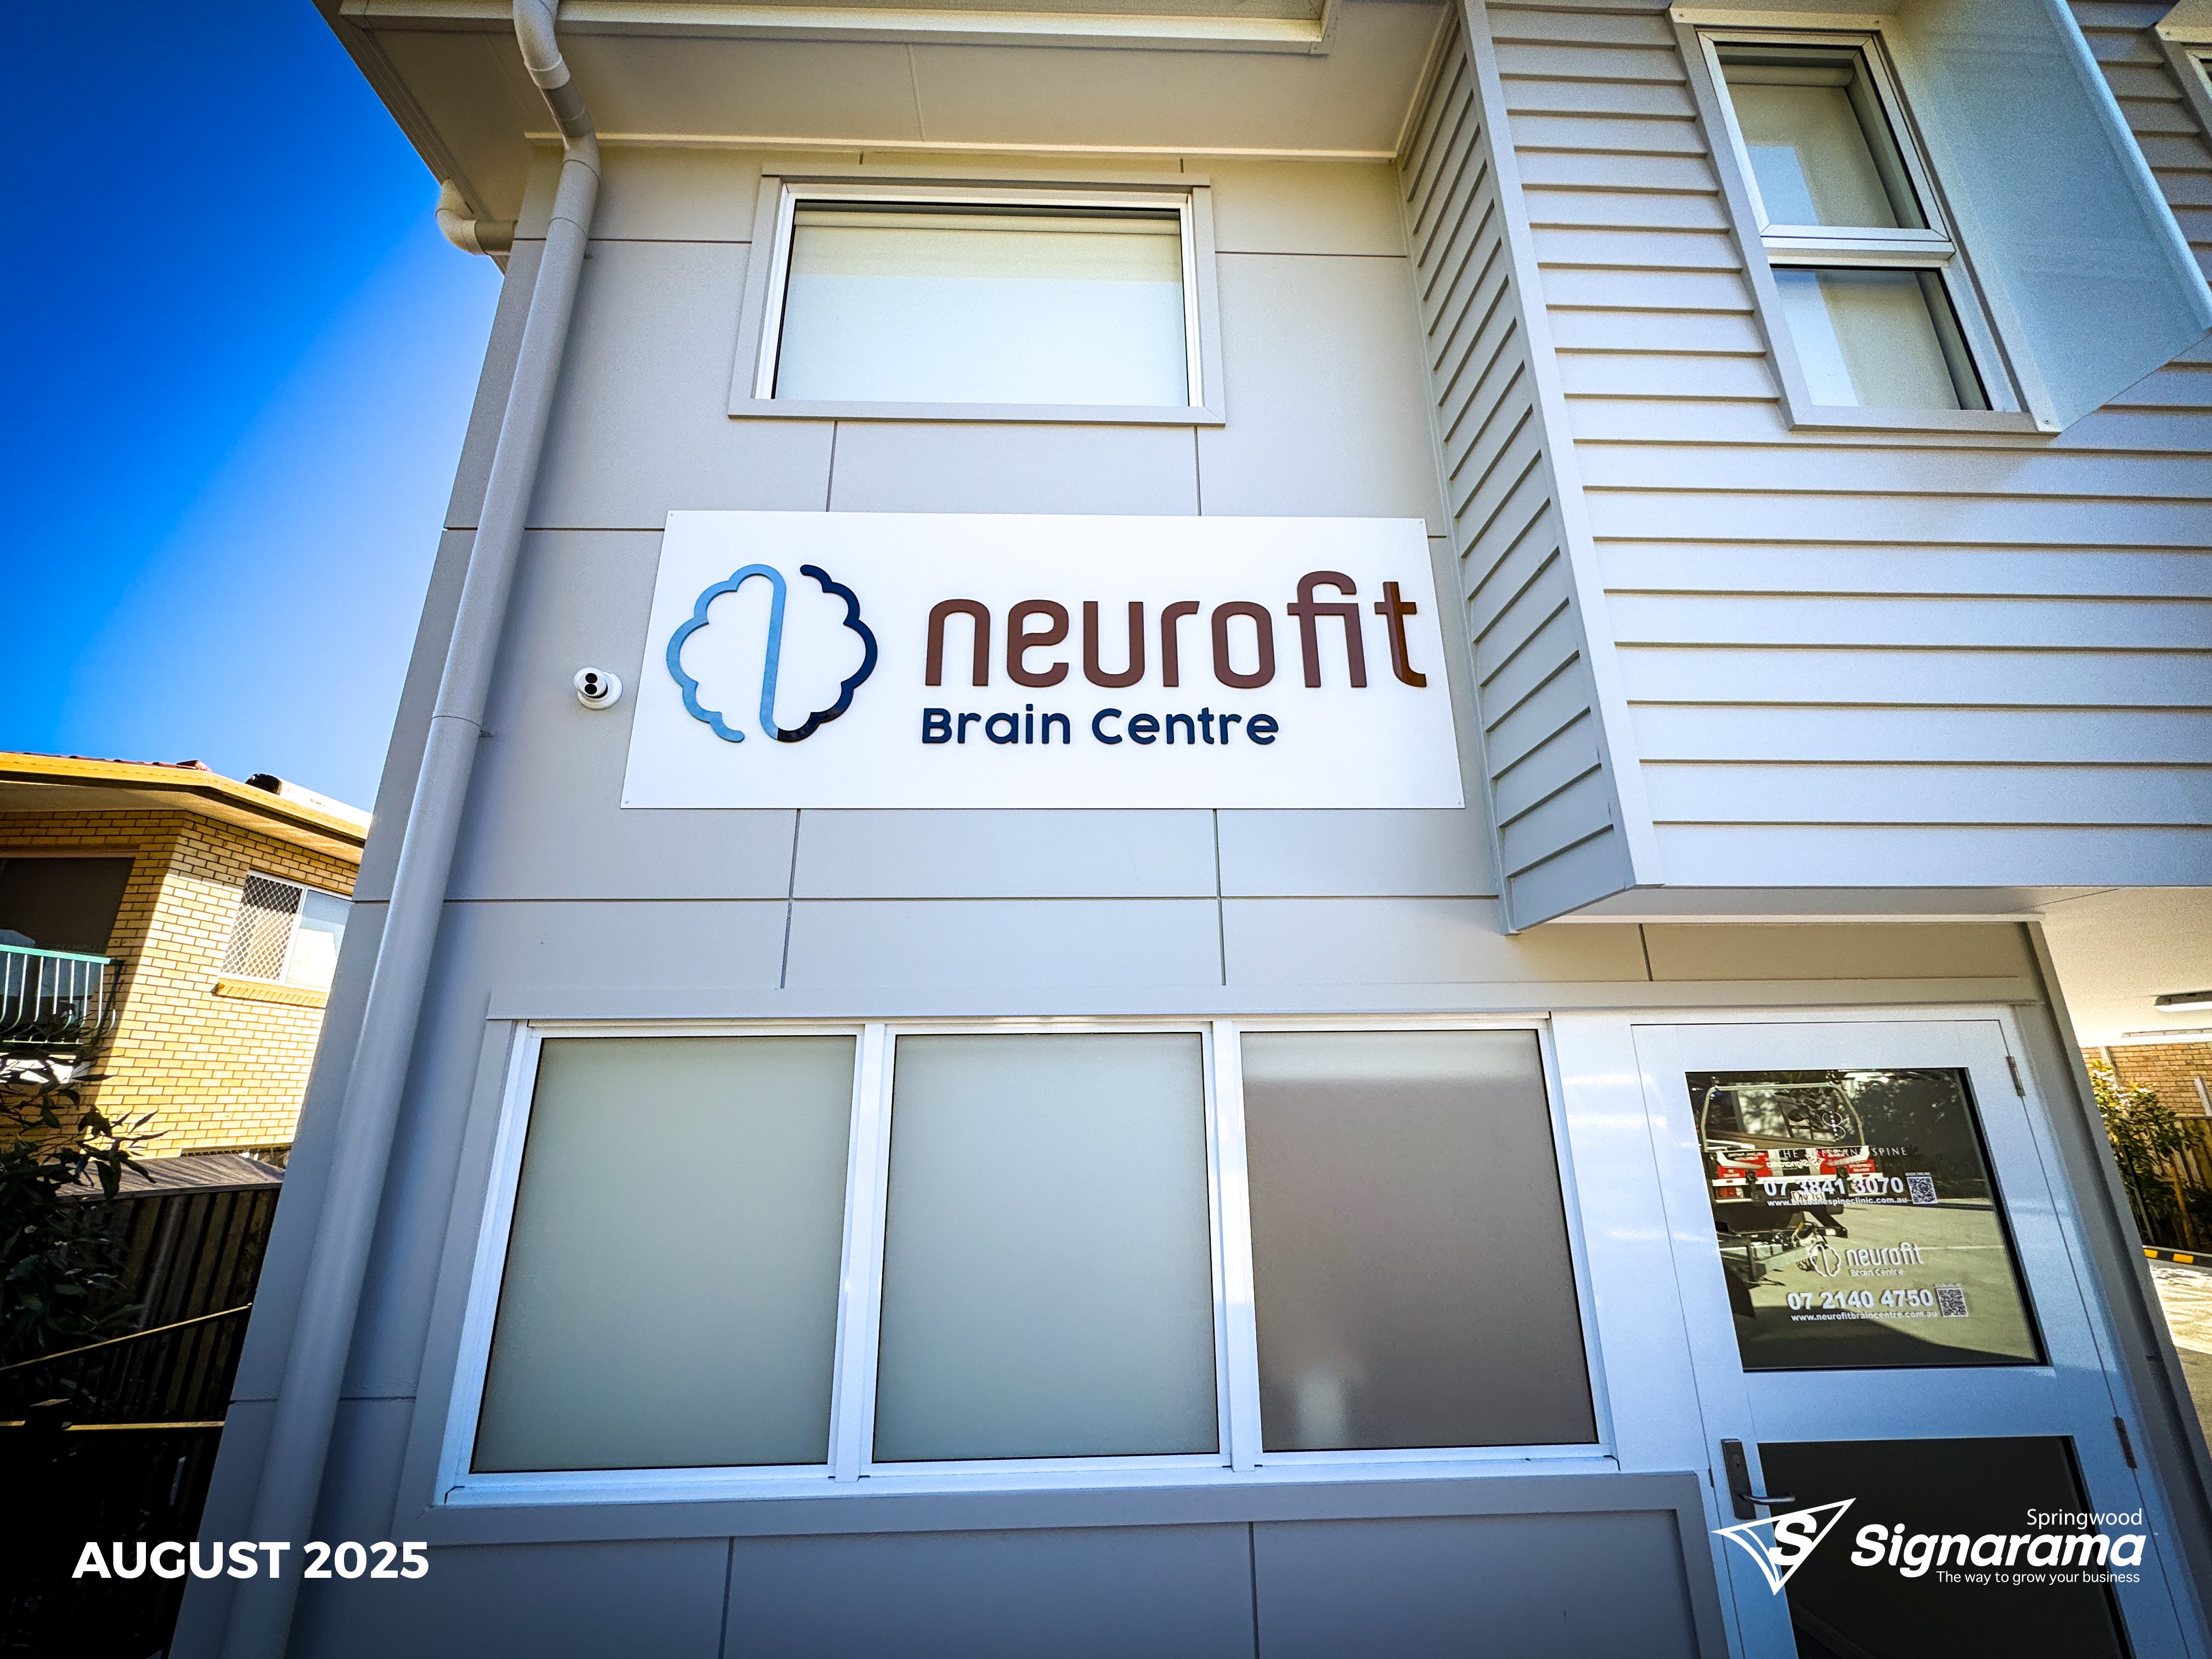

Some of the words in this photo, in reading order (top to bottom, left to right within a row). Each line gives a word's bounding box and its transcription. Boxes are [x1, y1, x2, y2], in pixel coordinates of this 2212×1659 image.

[924, 570, 1428, 689] neurofit
[922, 703, 1070, 745] Brain
[1092, 707, 1279, 746] Centre
[1872, 1147, 1908, 1156] SPINE
[1763, 1180, 1788, 1197] 07
[1796, 1178, 1846, 1195] 3841
[1852, 1177, 1904, 1194] 3070
[1846, 1242, 1924, 1266] neurofit
[1850, 1267, 1874, 1277] Brain
[1787, 1292, 1813, 1311] 07
[1820, 1290, 1875, 1310] 2140
[1880, 1289, 1934, 1307] 4750
